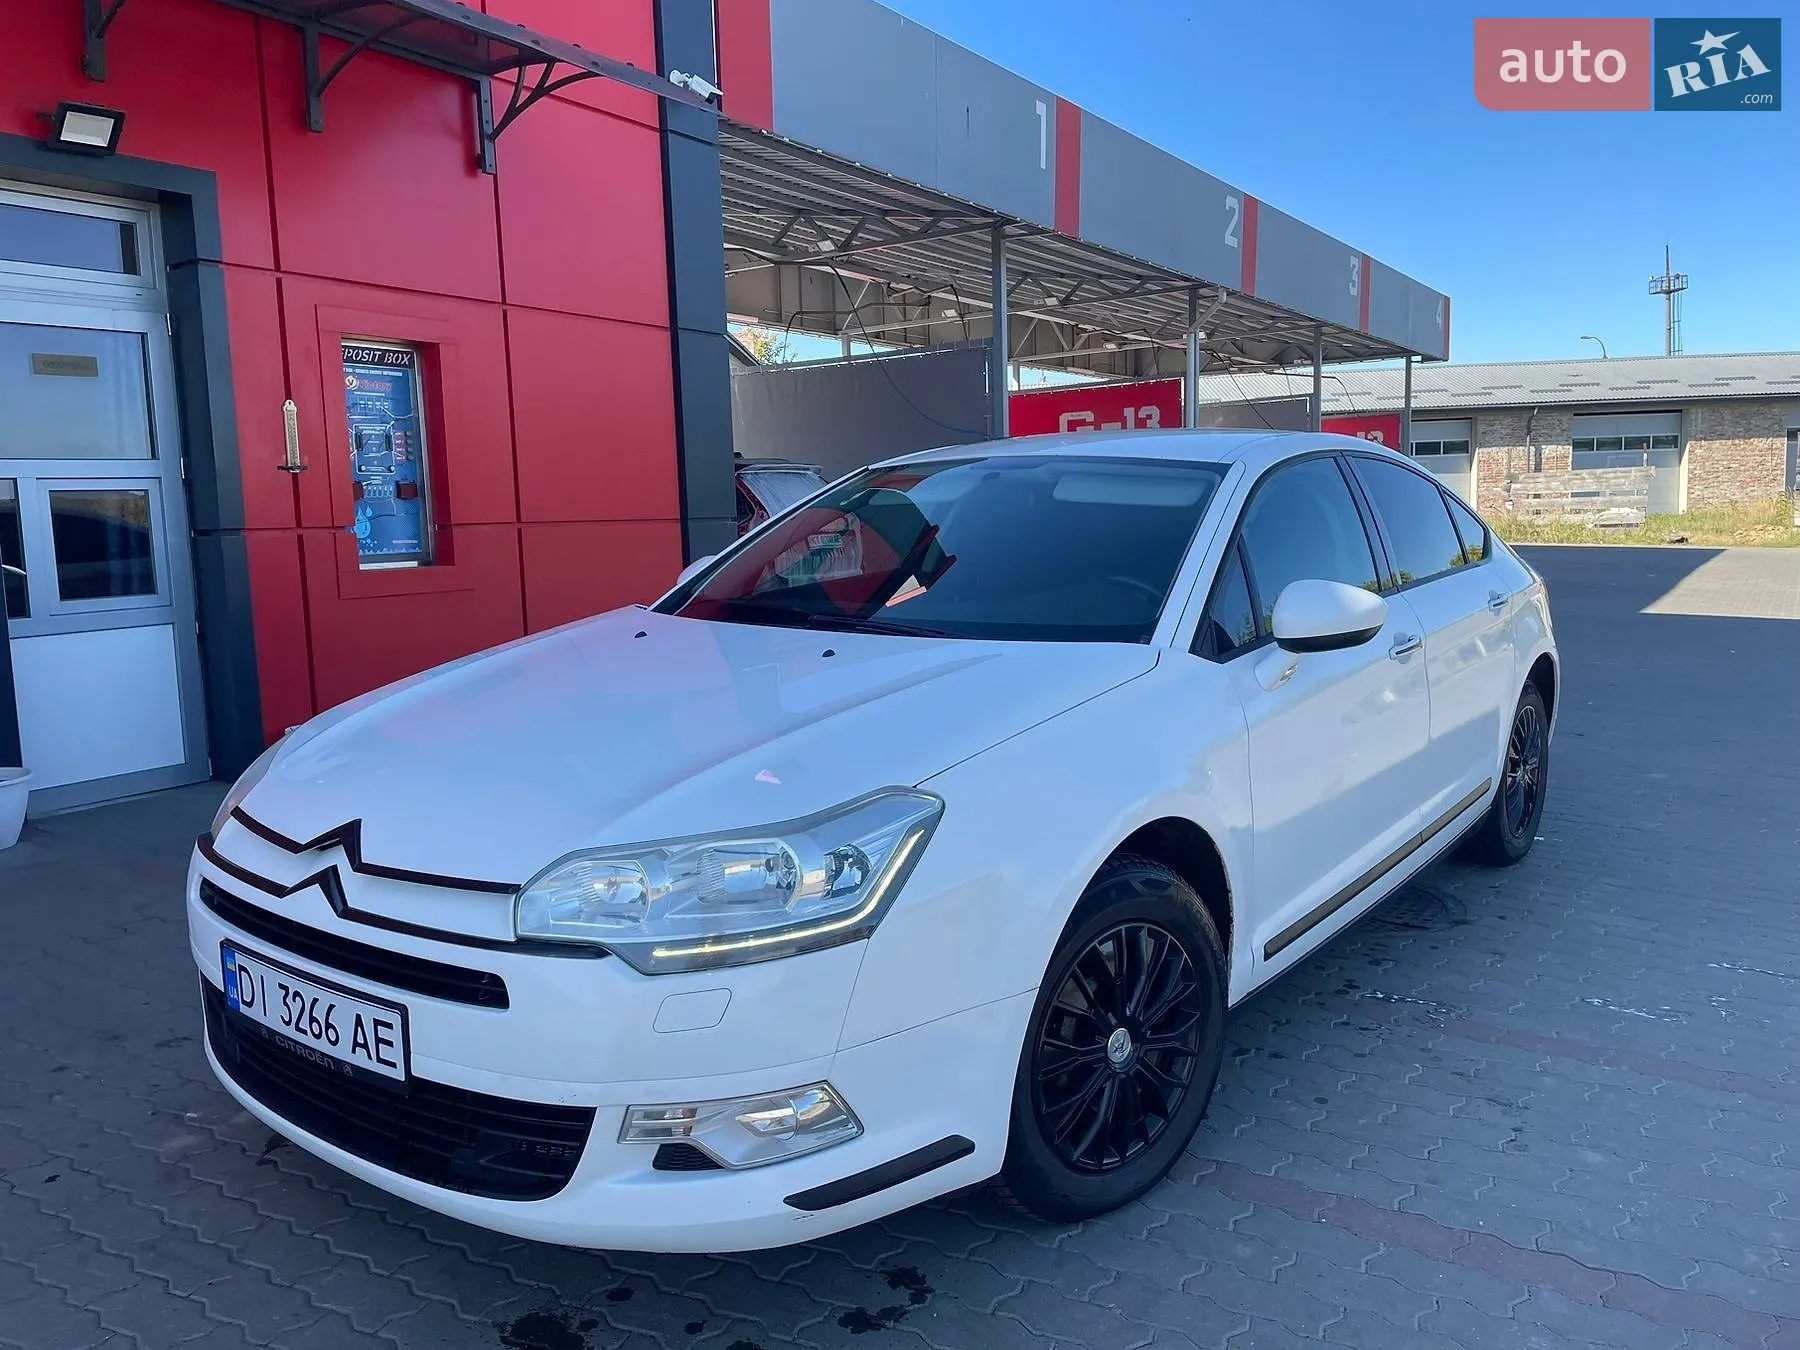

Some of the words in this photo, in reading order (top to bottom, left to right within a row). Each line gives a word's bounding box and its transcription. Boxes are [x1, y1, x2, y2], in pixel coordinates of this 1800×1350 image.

[1035, 99, 1048, 170] 1
[1225, 195, 1238, 248] 2
[1349, 255, 1359, 297] 3
[341, 347, 382, 363] POSIT
[384, 352, 411, 365] BOX
[228, 984, 239, 1001] UA
[237, 963, 268, 1017] DI
[277, 981, 340, 1047] 3266
[351, 1013, 398, 1070] AE
